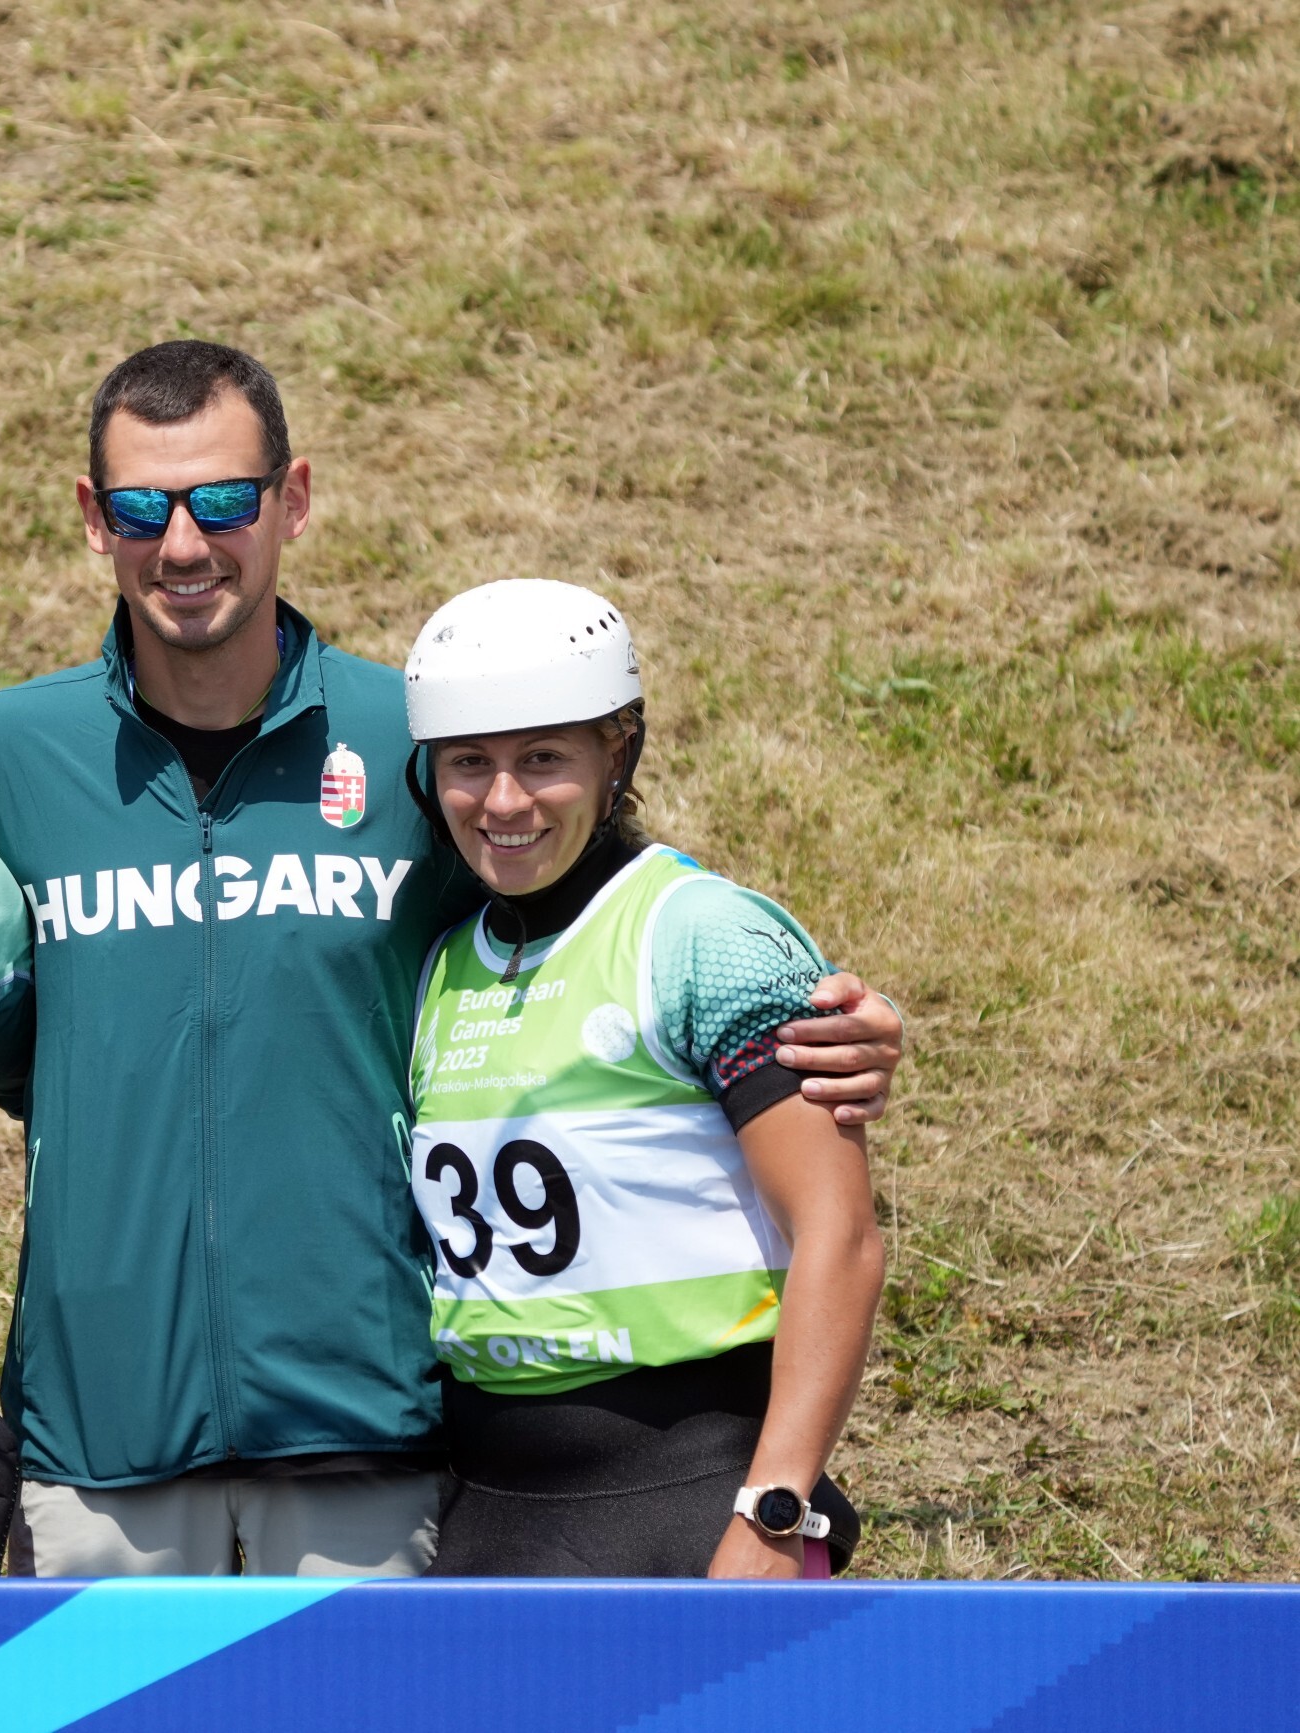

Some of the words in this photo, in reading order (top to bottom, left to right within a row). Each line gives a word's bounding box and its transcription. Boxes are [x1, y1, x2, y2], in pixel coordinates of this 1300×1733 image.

[22, 853, 414, 945] HUNGARY
[456, 978, 566, 1014] European
[450, 1015, 524, 1043] Games
[436, 1044, 491, 1073] 2023
[431, 1071, 547, 1095] Kraków-Małopolska
[425, 1138, 581, 1279] 39
